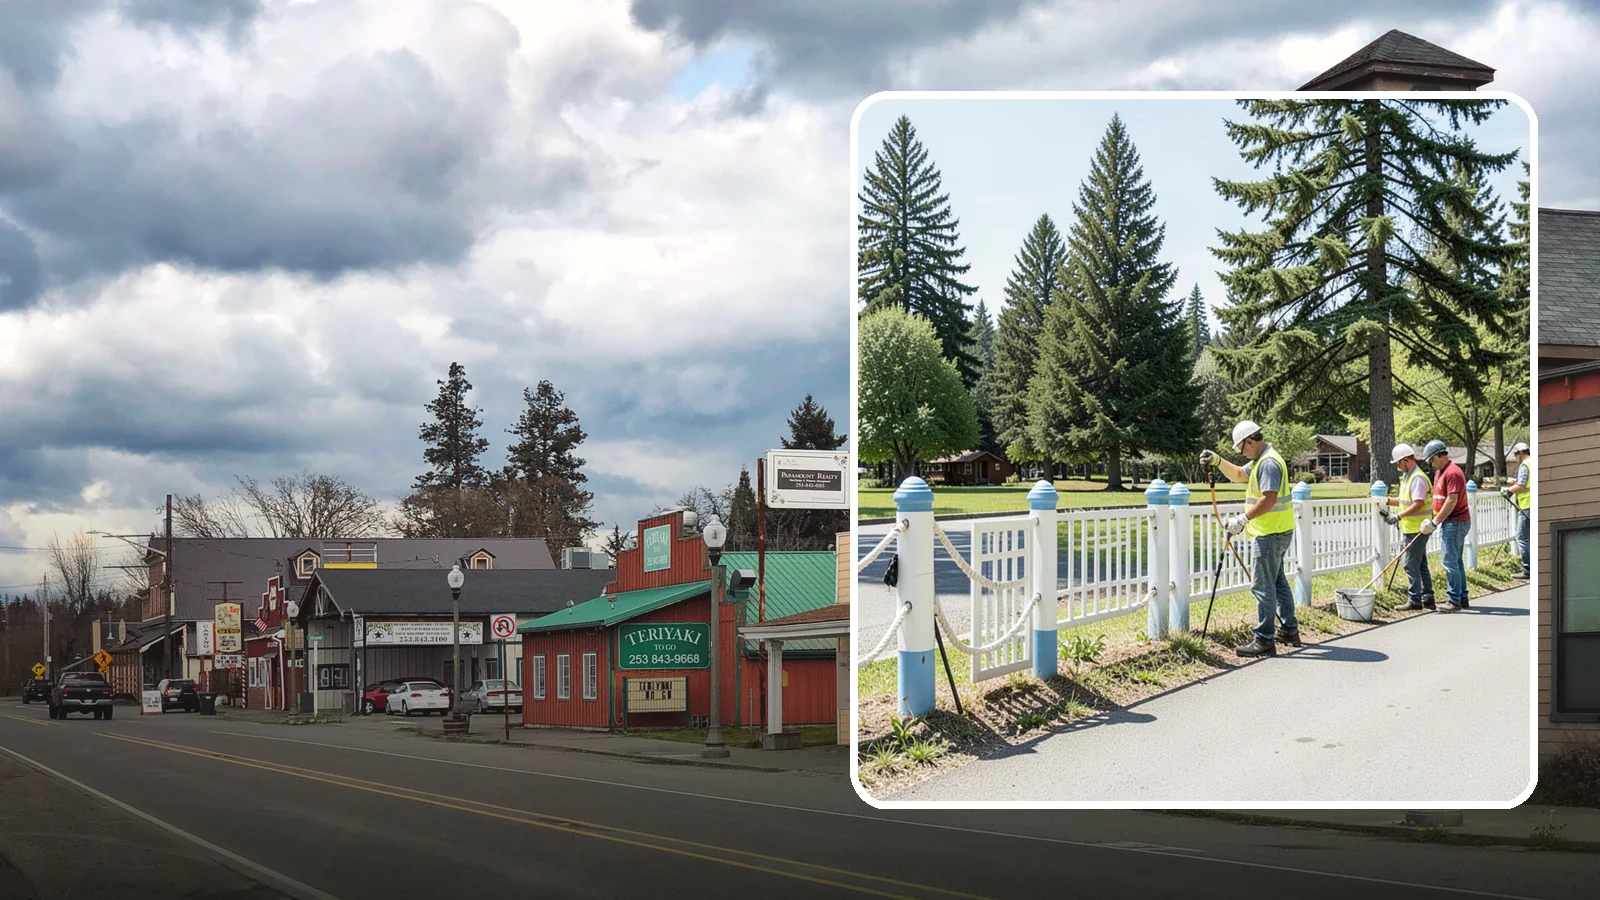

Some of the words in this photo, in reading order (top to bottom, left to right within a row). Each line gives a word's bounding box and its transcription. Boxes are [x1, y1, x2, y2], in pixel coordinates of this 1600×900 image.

[625, 627, 703, 646] TERIYAKI
[628, 654, 648, 665] 253
[651, 653, 700, 664] 843-9668
